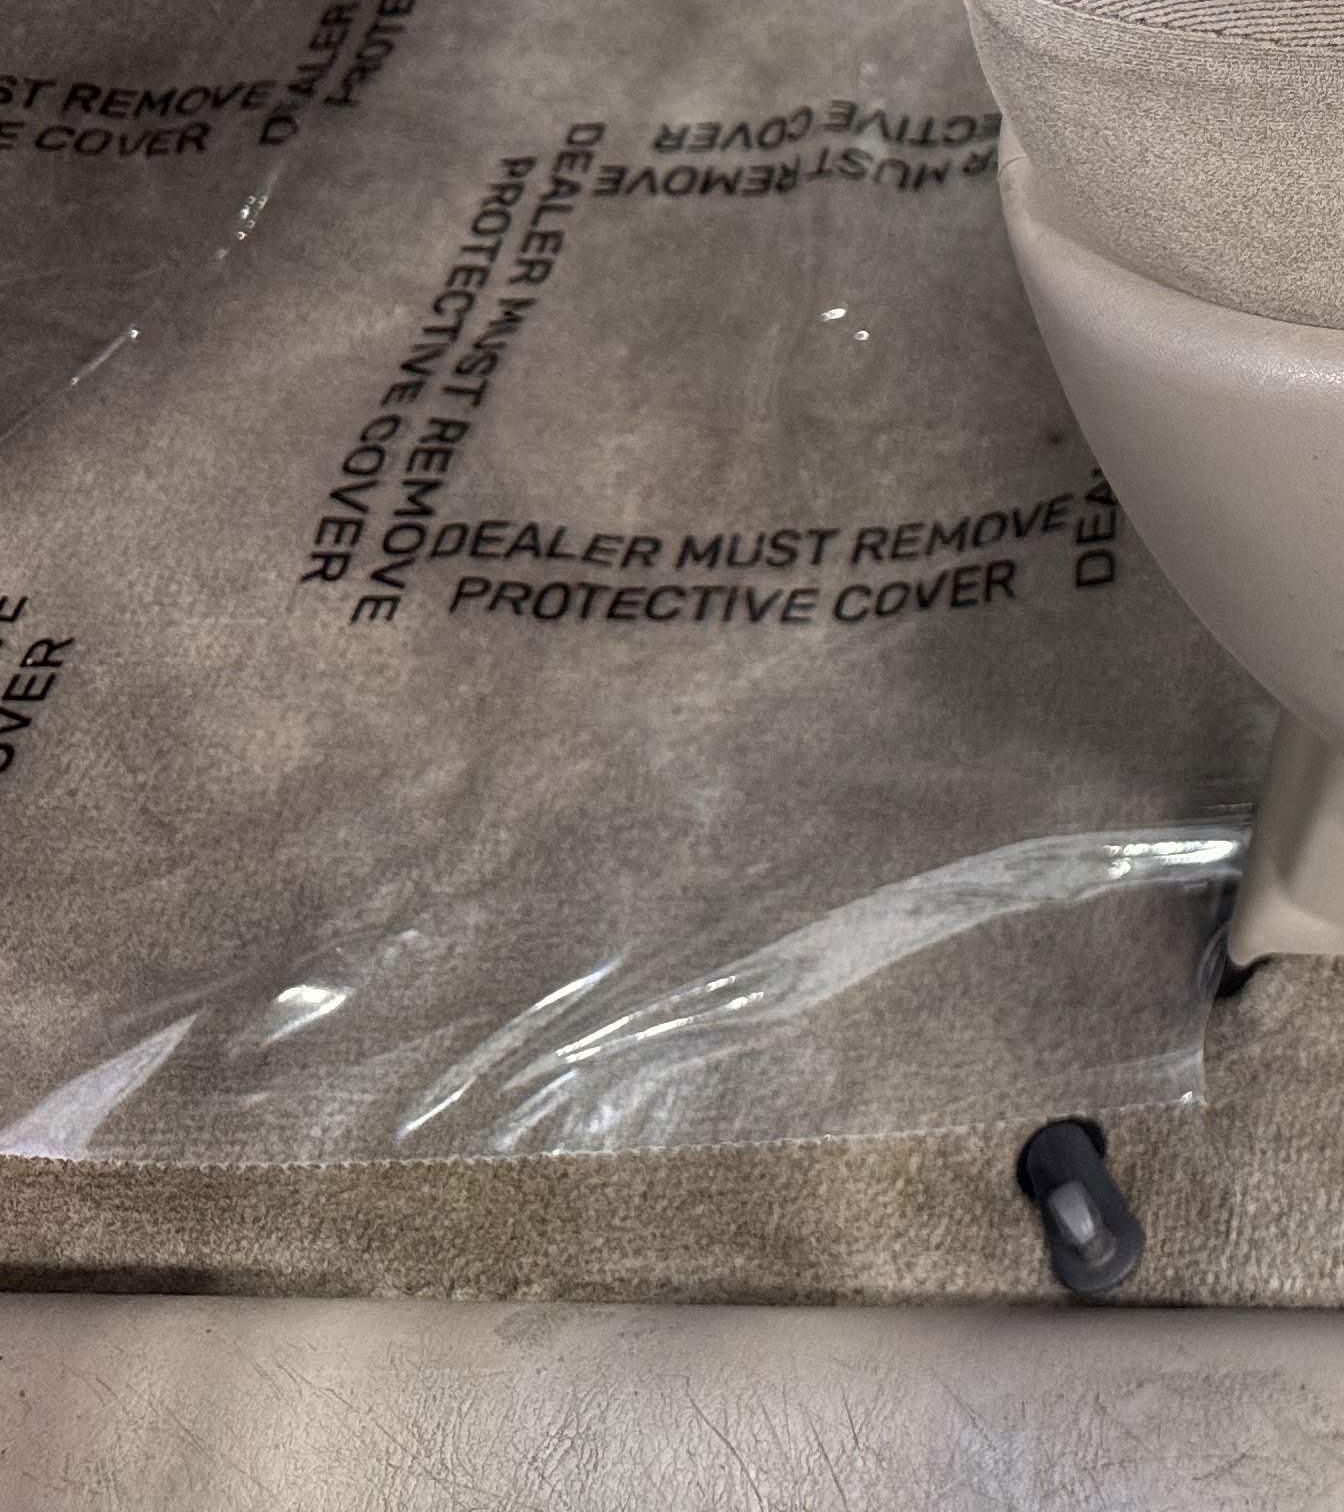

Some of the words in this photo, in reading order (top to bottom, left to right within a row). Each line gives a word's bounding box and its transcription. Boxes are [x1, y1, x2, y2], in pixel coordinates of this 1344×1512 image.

[34, 122, 211, 157] COVER
[60, 80, 277, 119] REMOVE
[654, 105, 814, 154] COVER
[508, 121, 606, 288] DEALER
[594, 150, 800, 198] REMOVE
[806, 145, 951, 192] MUST
[381, 155, 537, 408] PROTECTIVE
[441, 297, 538, 408] MUST
[300, 413, 402, 586] COVER
[350, 416, 472, 626] REMOVE
[430, 520, 663, 570] DEALER
[675, 527, 841, 573] MUST
[851, 492, 1075, 566] REMOVE
[1075, 467, 1120, 588] DEA
[450, 575, 820, 626] PROTECTIVE
[833, 558, 1018, 625] COVER
